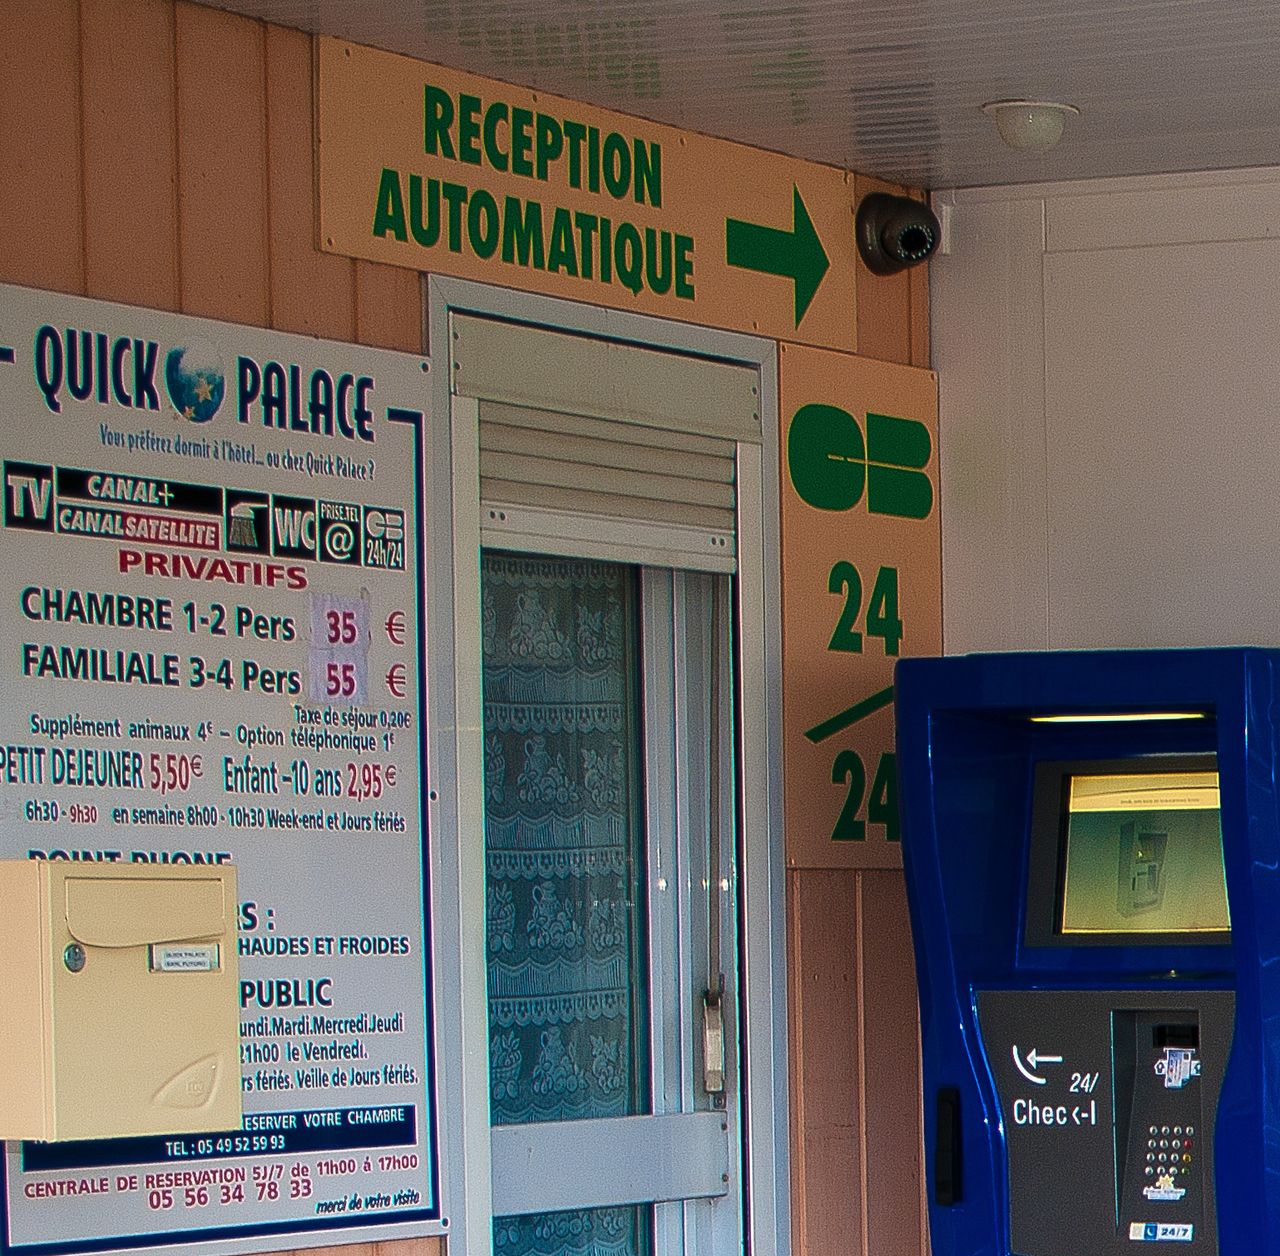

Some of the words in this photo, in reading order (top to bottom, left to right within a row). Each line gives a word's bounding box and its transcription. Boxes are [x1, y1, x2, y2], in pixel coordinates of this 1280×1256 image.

[424, 84, 662, 208] RECEPTION
[372, 168, 696, 300] AUTOMATIQUE
[34, 324, 161, 413] QUICK
[237, 356, 375, 442] PALACE
[100, 424, 125, 448] Vous
[128, 430, 172, 454] préférez
[174, 434, 210, 460] dormir
[213, 441, 219, 460] à
[267, 453, 279, 468] ou
[282, 450, 304, 472] chez
[306, 452, 334, 477] Quick
[337, 455, 367, 480] Palace
[88, 475, 174, 507] CANAL+
[7, 475, 51, 520] TV
[274, 507, 315, 550] WC
[118, 549, 308, 590] PRIVATIFS
[367, 539, 402, 568] 24h/24
[21, 587, 172, 632] CHAMBRE
[183, 602, 227, 636] 1-2
[236, 605, 296, 642] Pers
[326, 610, 357, 644] 35
[384, 611, 407, 645] €
[827, 560, 903, 656] 24
[22, 643, 181, 687] FAMILIALE
[189, 658, 234, 690] 3-4
[243, 660, 301, 695] Pers
[326, 663, 356, 697] 55
[385, 664, 407, 698] €
[31, 714, 121, 740] Supplément
[129, 719, 190, 741] animaux
[237, 725, 284, 747] Option
[291, 727, 376, 754] téléphonique
[294, 705, 321, 725] Taxe
[324, 706, 339, 726] de
[341, 707, 378, 731] séjour
[0, 746, 46, 784] PETIT
[51, 748, 144, 789] DEJEUNER
[223, 755, 278, 794] Enfant
[314, 767, 342, 796] ans
[25, 800, 59, 822] 6h30
[70, 804, 98, 823] 9h30
[112, 807, 129, 824] en
[132, 804, 185, 825] semaine
[187, 805, 218, 827] 8h00
[228, 807, 264, 828] 10h30
[267, 808, 324, 830] Week-end
[327, 811, 339, 830] et
[342, 811, 372, 831] Jours
[374, 810, 406, 832] fériés
[313, 937, 334, 955] ET
[339, 936, 410, 956] FROIDES
[240, 978, 333, 1008] PUBLIC
[286, 1042, 300, 1062] le
[256, 1070, 294, 1090] fériés.
[296, 1067, 329, 1088] Veille
[332, 1067, 347, 1087] de
[350, 1067, 381, 1086] Jours
[382, 1063, 418, 1084] fériés.
[241, 1115, 297, 1131] ESERVER
[304, 1112, 342, 1128] VOTRE
[348, 1108, 405, 1124] CHAMBRE
[165, 1141, 188, 1156] TEL
[198, 1139, 212, 1154] 05
[216, 1138, 232, 1153] 49
[235, 1137, 250, 1152] 52
[253, 1136, 268, 1151] 59
[271, 1135, 285, 1149] 93
[24, 1177, 109, 1198] CENTRALE
[117, 1175, 138, 1191] DE
[145, 1167, 245, 1189] RESERVATION
[253, 1164, 283, 1181] 5J/7
[291, 1163, 309, 1178] de
[317, 1159, 355, 1175] 11h00
[378, 1154, 418, 1171] 17h00
[149, 1189, 173, 1210] 05
[185, 1186, 209, 1206] 56
[220, 1184, 244, 1204] 34
[256, 1181, 279, 1201] 78
[290, 1179, 312, 1199] 33
[316, 1195, 347, 1214] merci
[349, 1193, 361, 1210] de
[364, 1192, 390, 1209] votre
[393, 1189, 420, 1206] visite
[1160, 1227, 1188, 1237] 24/7
